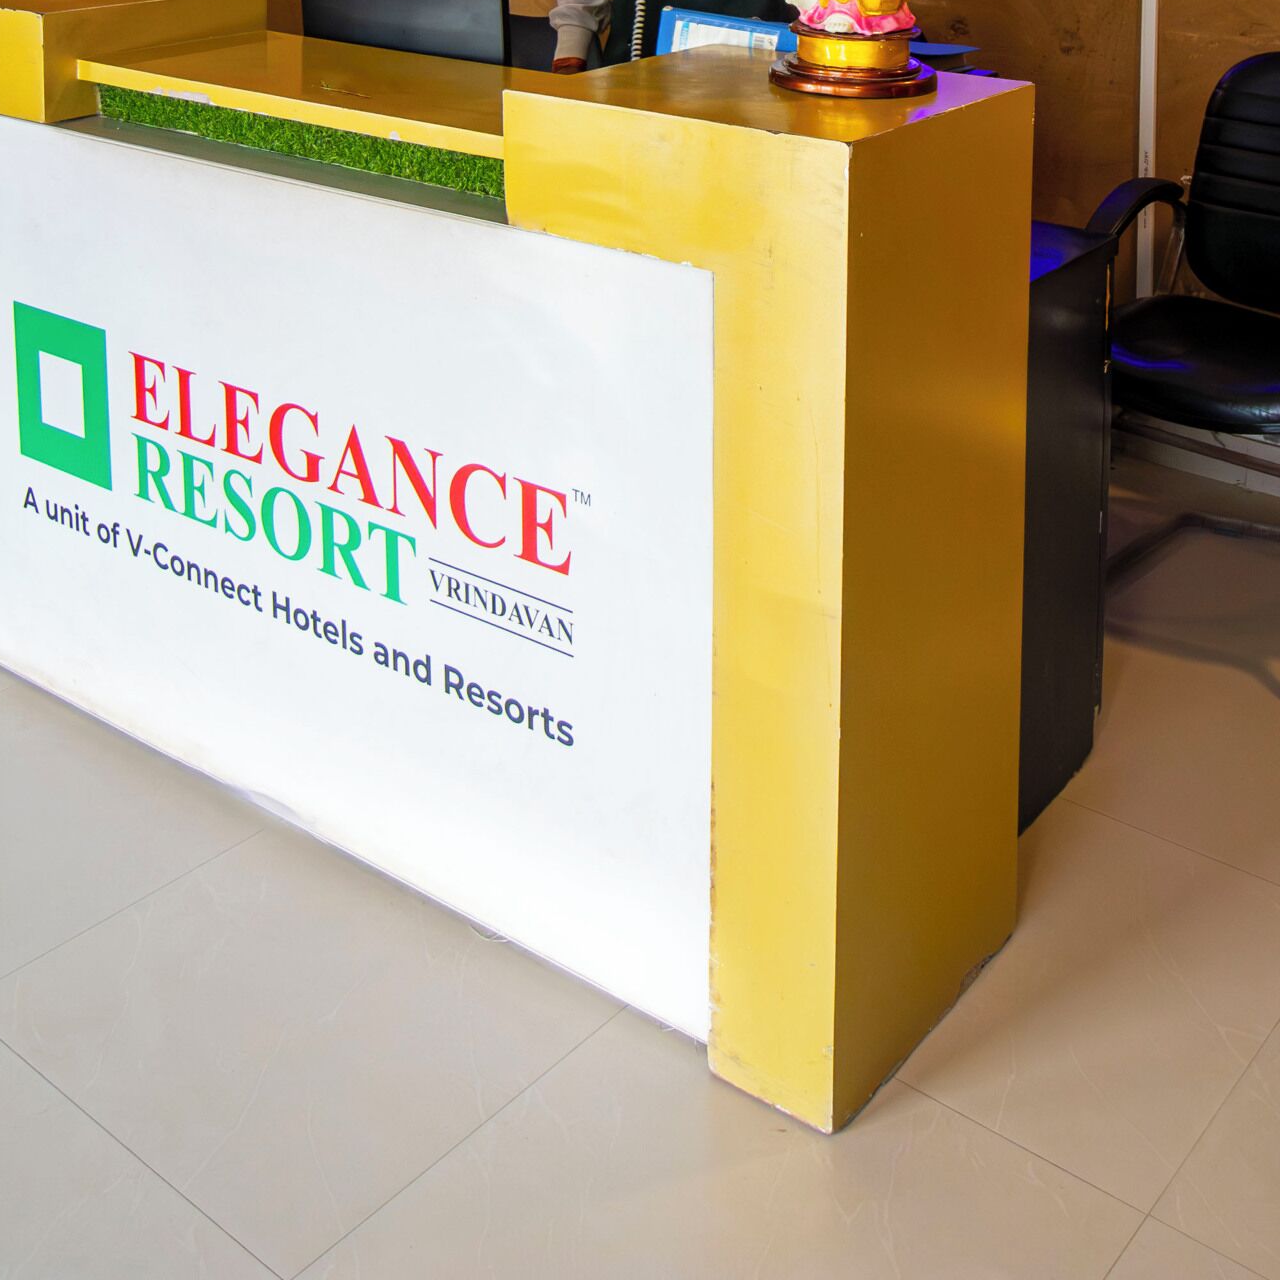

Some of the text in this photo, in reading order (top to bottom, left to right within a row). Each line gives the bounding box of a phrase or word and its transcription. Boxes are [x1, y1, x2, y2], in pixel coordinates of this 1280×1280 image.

[128, 351, 573, 577] ELEGANCE
[132, 432, 418, 607] RESORT
[23, 486, 576, 748] A unit of V-Connect Hotels and Resorts
[428, 569, 575, 646] VRINDAVAN
